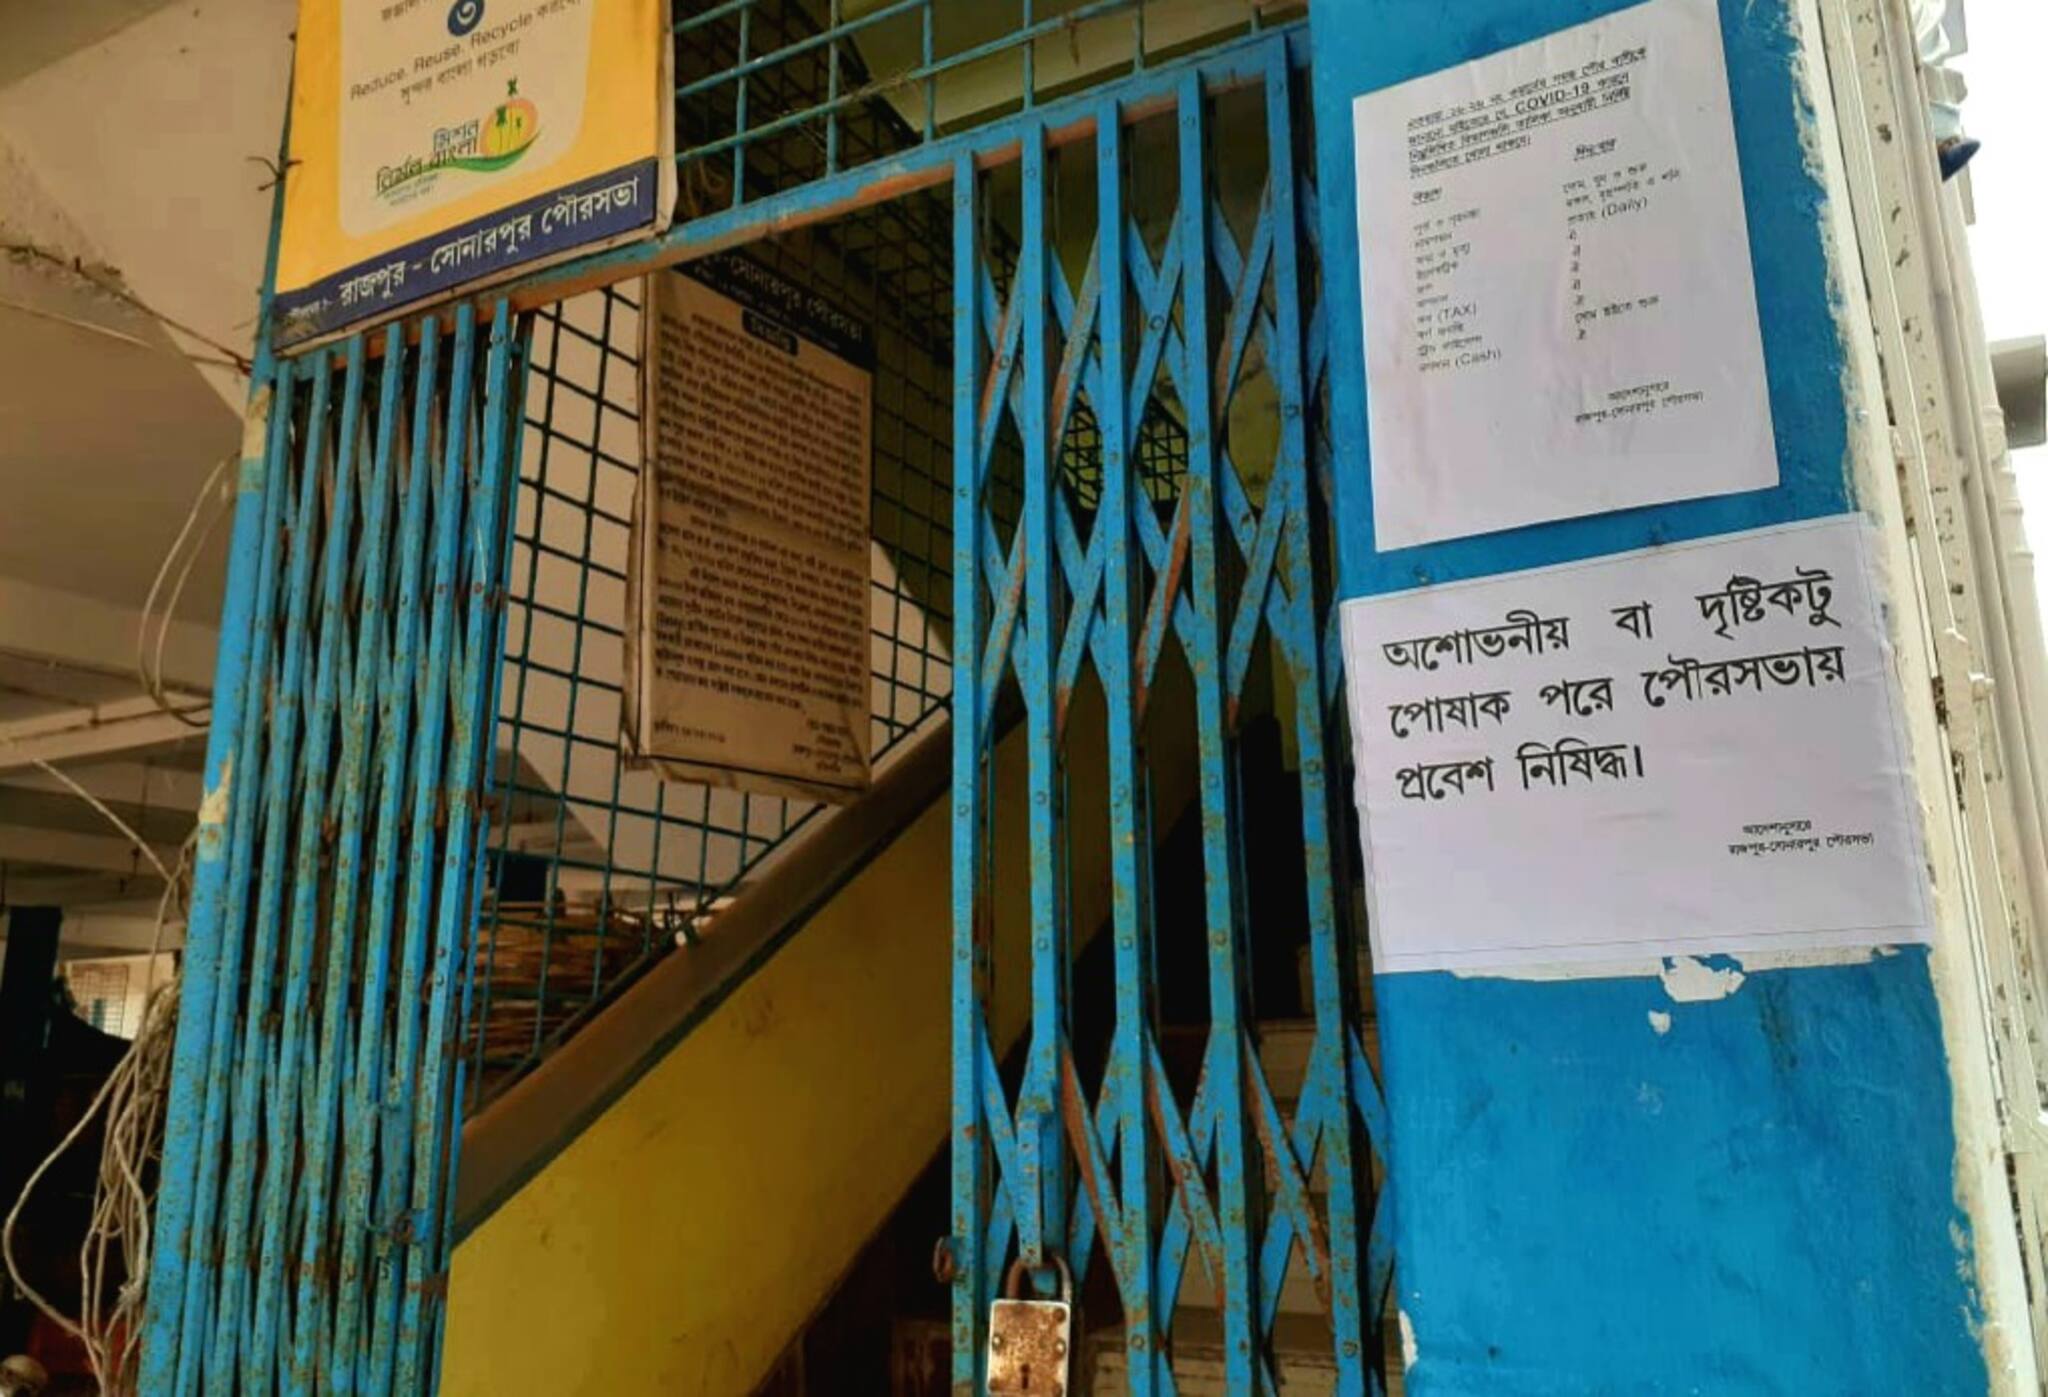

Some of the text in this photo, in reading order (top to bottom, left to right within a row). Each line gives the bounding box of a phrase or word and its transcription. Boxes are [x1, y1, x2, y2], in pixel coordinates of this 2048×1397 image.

[470, 12, 534, 49] Recycle
[1515, 81, 1590, 115] COVID-19
[1601, 197, 1648, 219] (Daily)
[339, 260, 405, 306] রাজপুর
[430, 213, 532, 274] সোনারপুর
[541, 175, 640, 235] পৌরসভা
[1437, 301, 1478, 322] (TAX)
[1455, 347, 1502, 369] (Cash)
[1383, 566, 1842, 671] অশোভনীয় বা দৃষ্টিকটু
[1388, 645, 1845, 738] পোষাক পরে পৌরসভায়
[1395, 737, 1644, 801] প্রবেশ নিষিদ্ধ।
